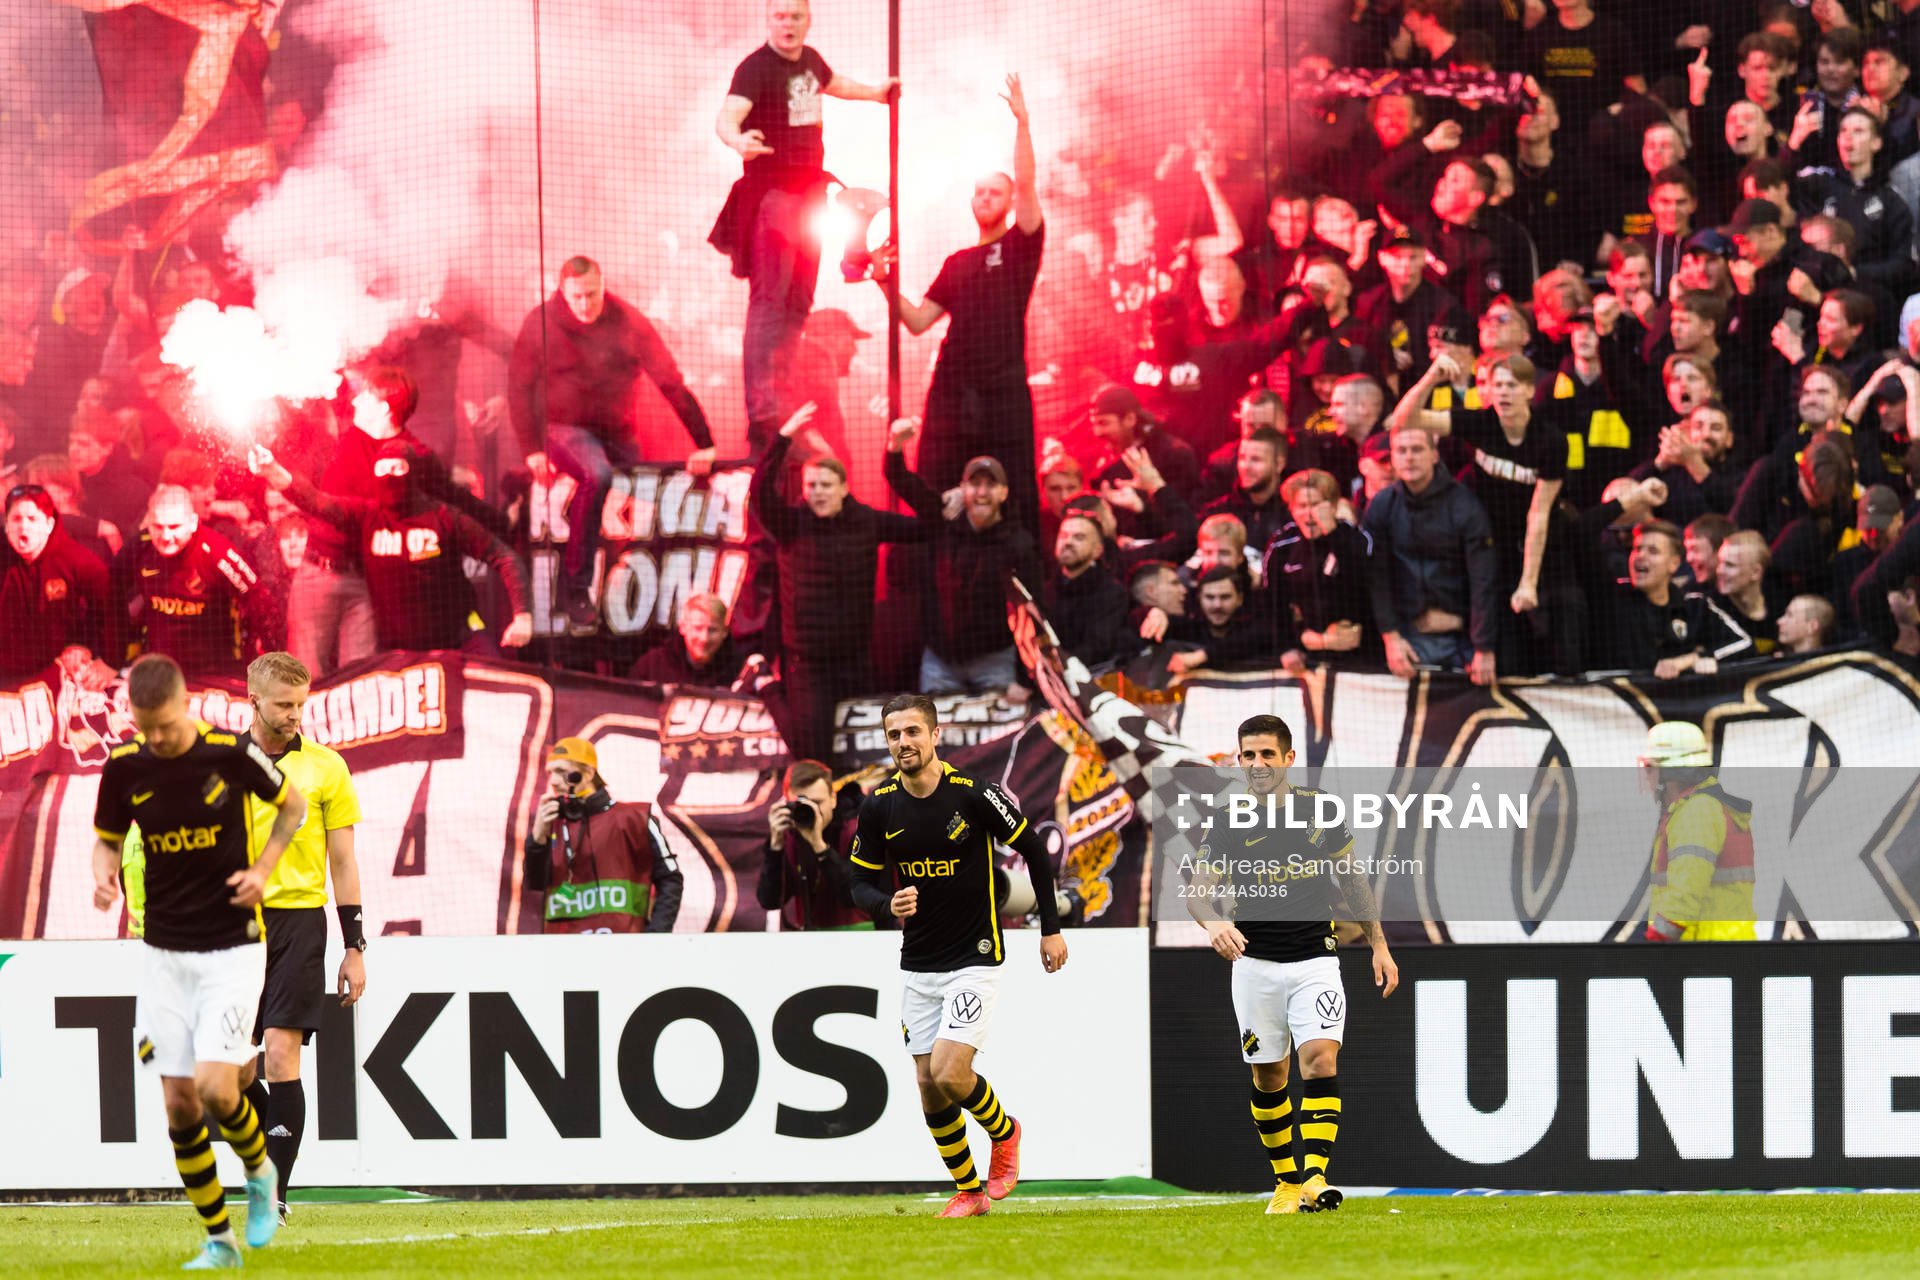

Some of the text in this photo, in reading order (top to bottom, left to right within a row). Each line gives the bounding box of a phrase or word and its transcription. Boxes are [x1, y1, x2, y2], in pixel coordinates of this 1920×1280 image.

[983, 788, 1017, 830] stadium
[148, 824, 222, 854] notar
[898, 857, 961, 878] notar
[547, 886, 626, 916] PHOTO
[54, 985, 888, 1142] TKNOS
